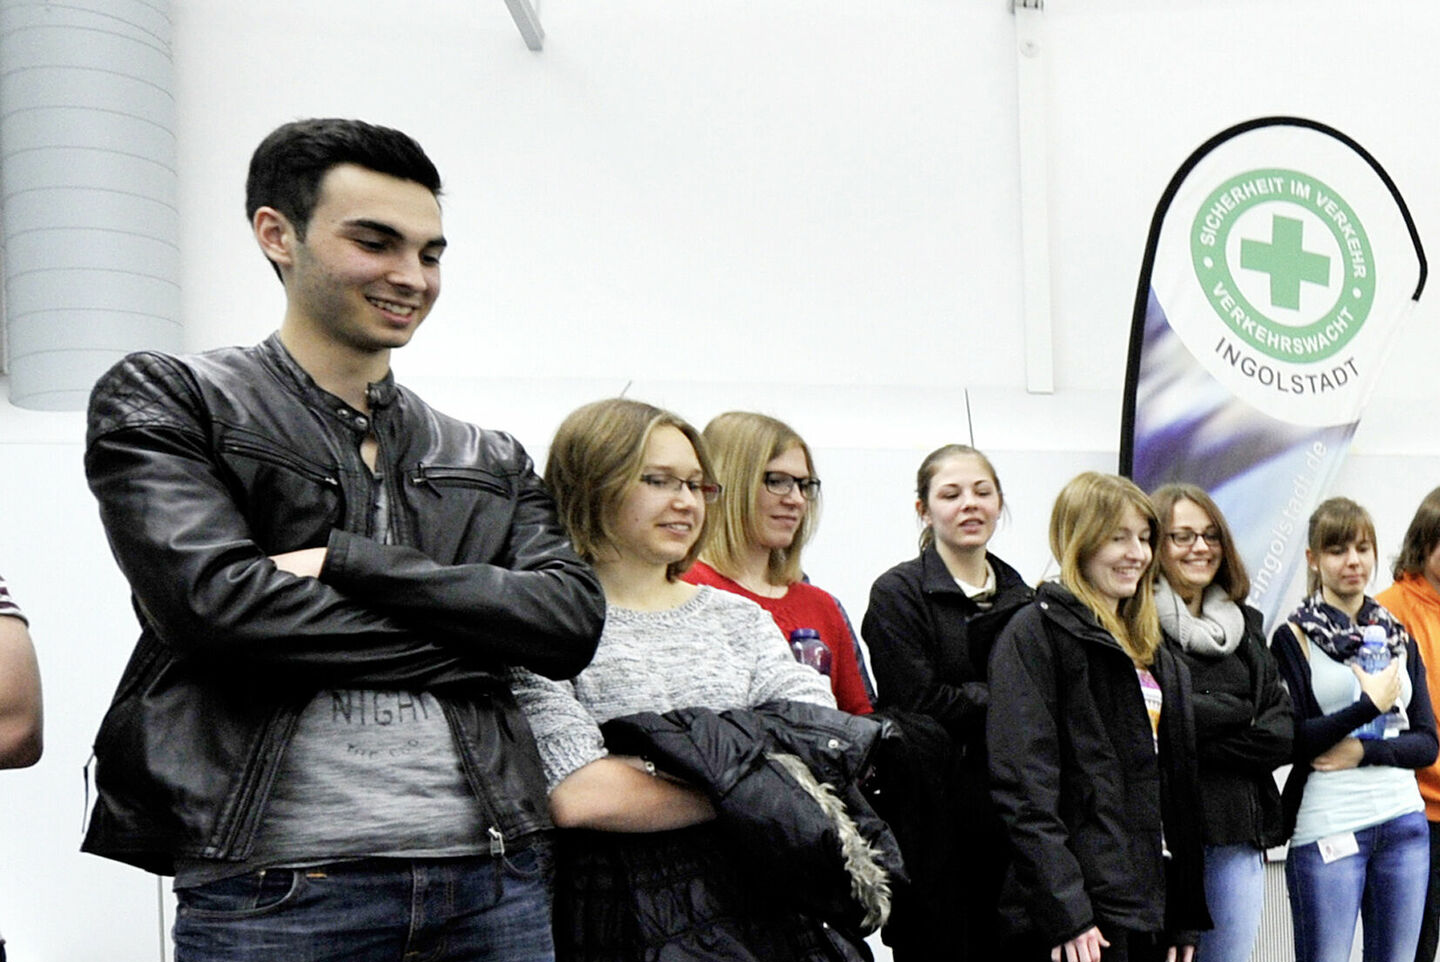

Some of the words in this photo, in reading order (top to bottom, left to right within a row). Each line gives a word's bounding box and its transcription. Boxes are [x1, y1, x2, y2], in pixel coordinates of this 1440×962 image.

[1200, 176, 1285, 247] SICHERHEIT
[1290, 179, 1311, 200] IM
[1316, 191, 1366, 278] VERKEHR
[1213, 281, 1354, 354] VERKEHRSWACHT
[1215, 336, 1360, 394] INGOLSTADT
